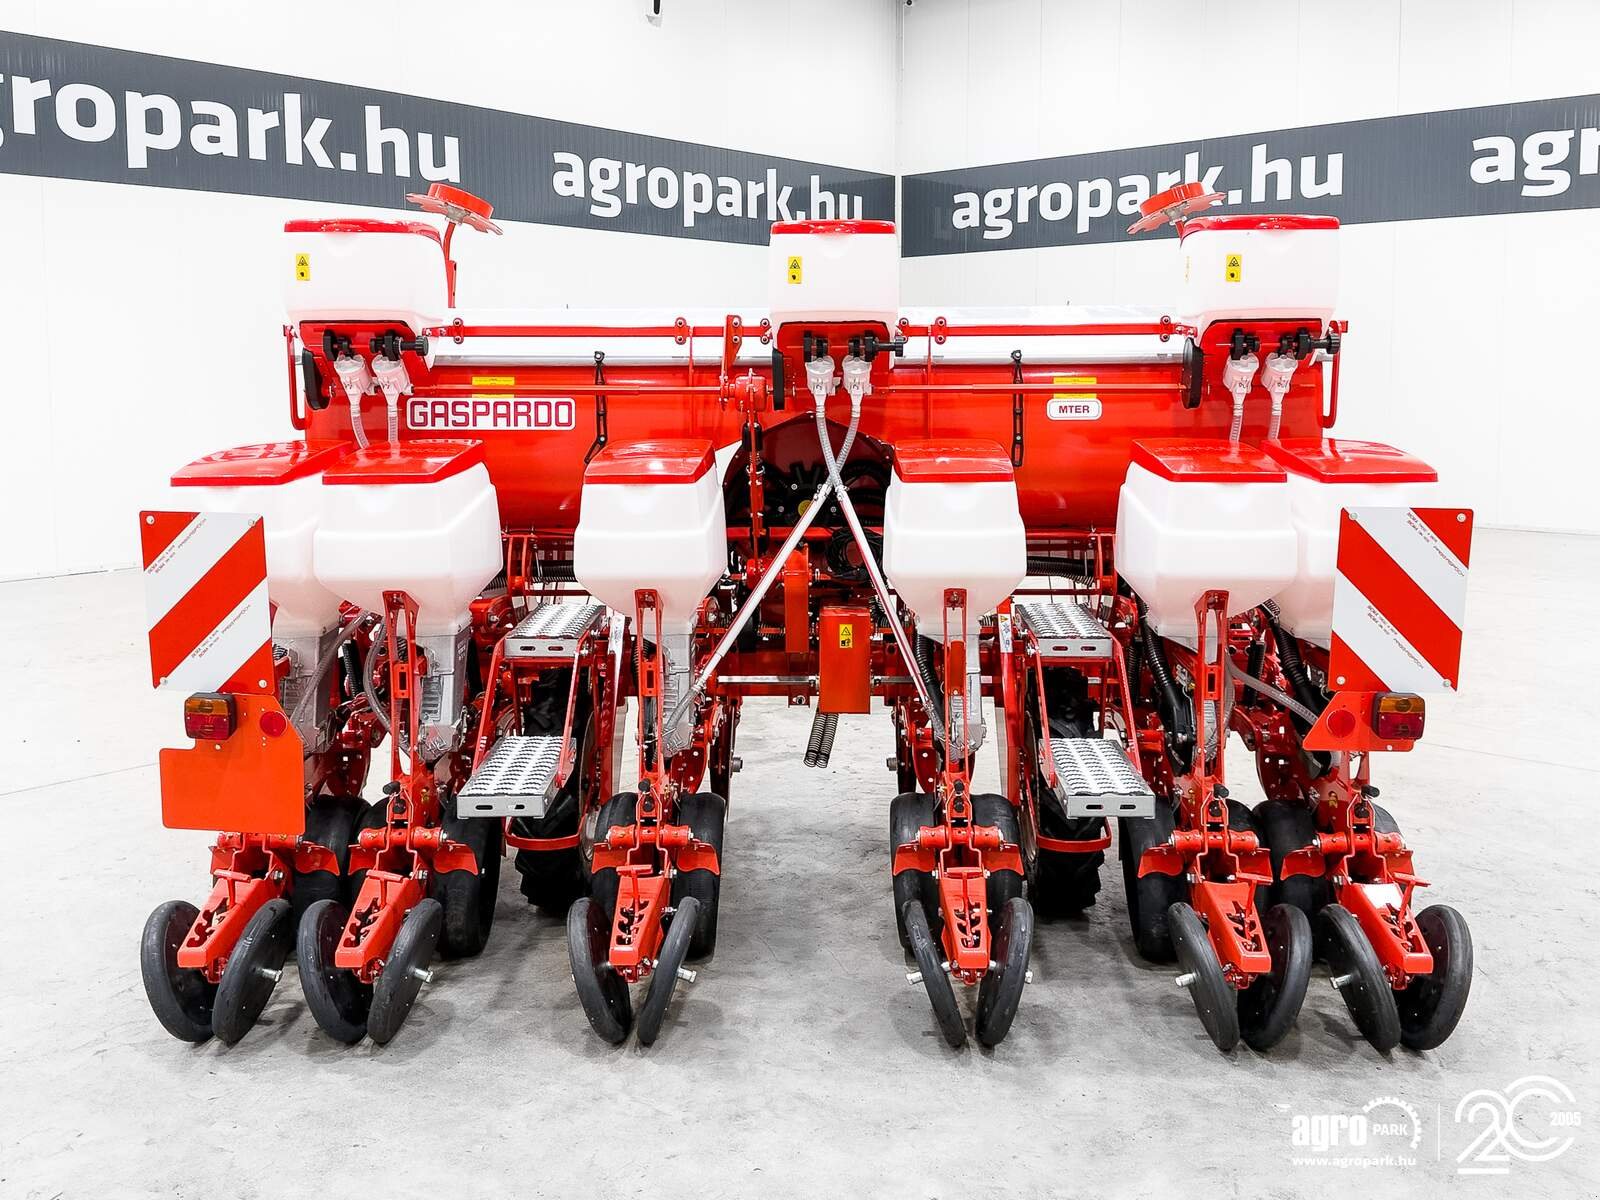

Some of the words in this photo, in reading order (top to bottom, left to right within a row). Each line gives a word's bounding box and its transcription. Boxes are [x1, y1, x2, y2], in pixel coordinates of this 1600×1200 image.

[0, 73, 461, 183] ropark.hu
[410, 401, 572, 427] GASPARDO
[1058, 405, 1090, 414] MTER
